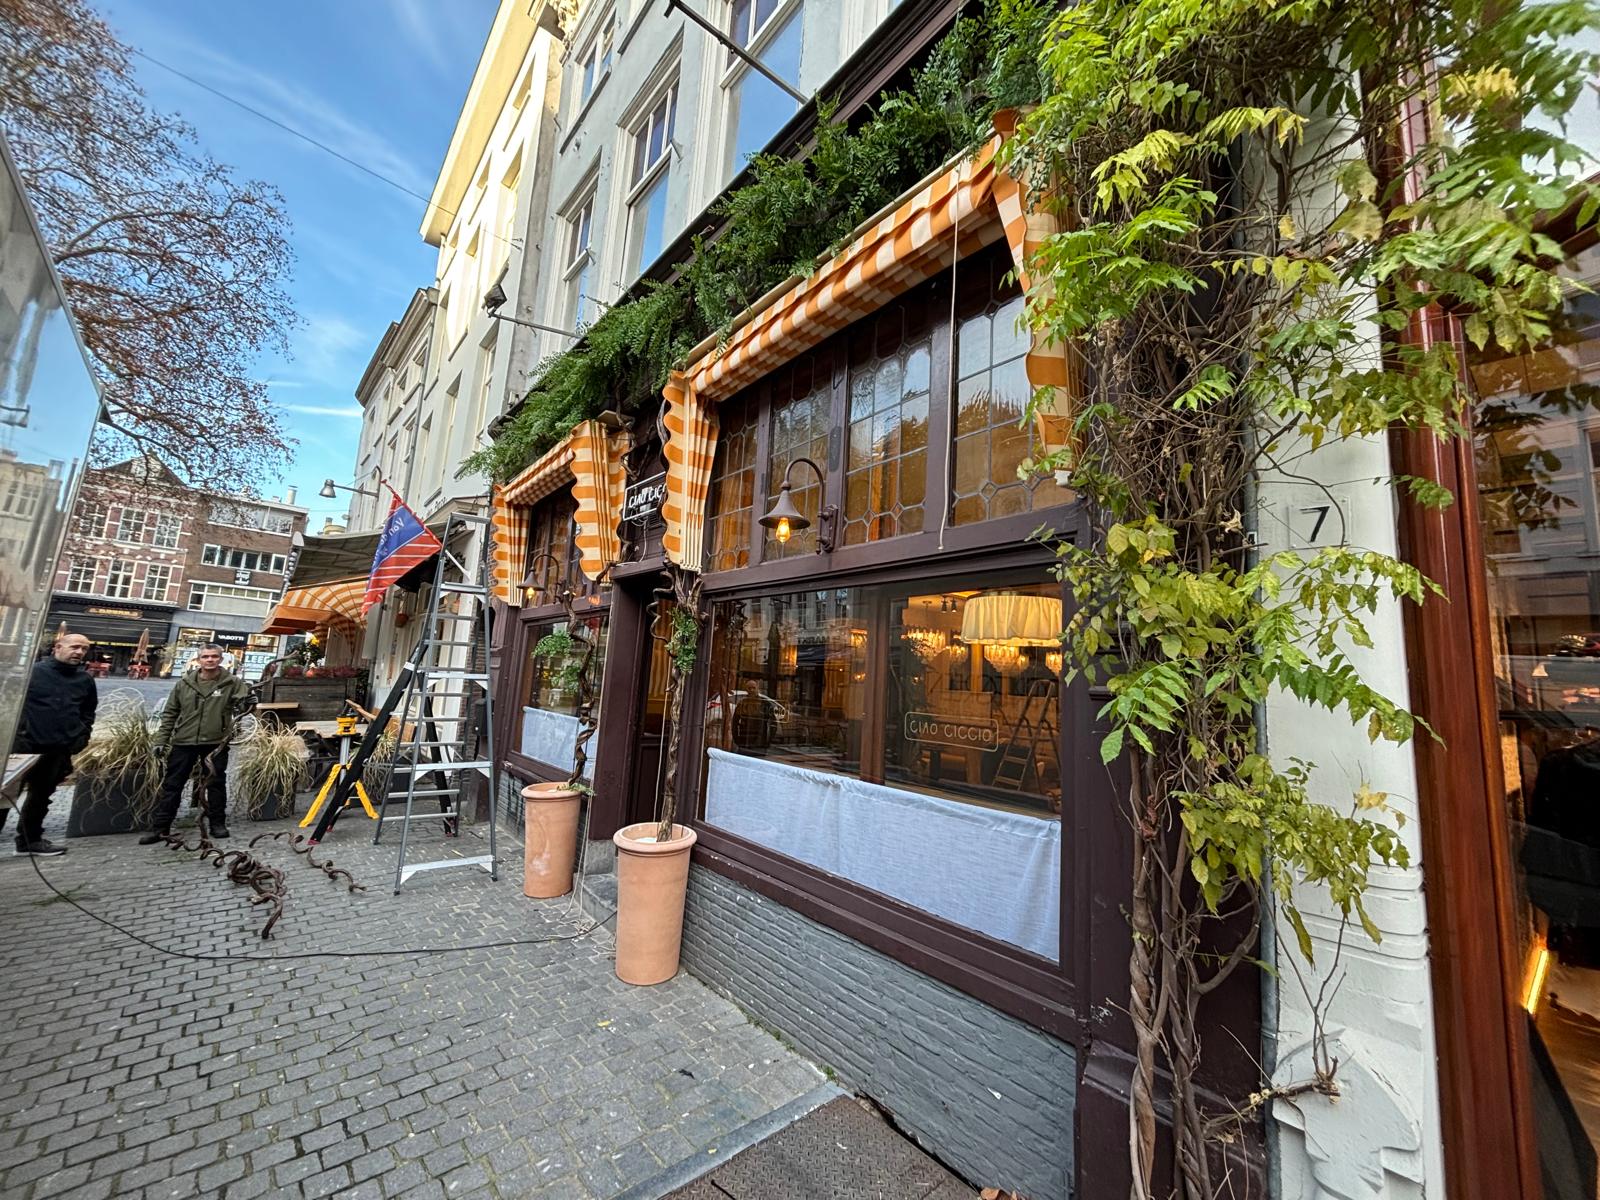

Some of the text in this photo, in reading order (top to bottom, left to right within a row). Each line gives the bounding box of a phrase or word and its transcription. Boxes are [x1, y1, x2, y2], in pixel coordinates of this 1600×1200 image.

[1299, 506, 1330, 542] 7
[909, 720, 992, 742] CIAO CICCIO
